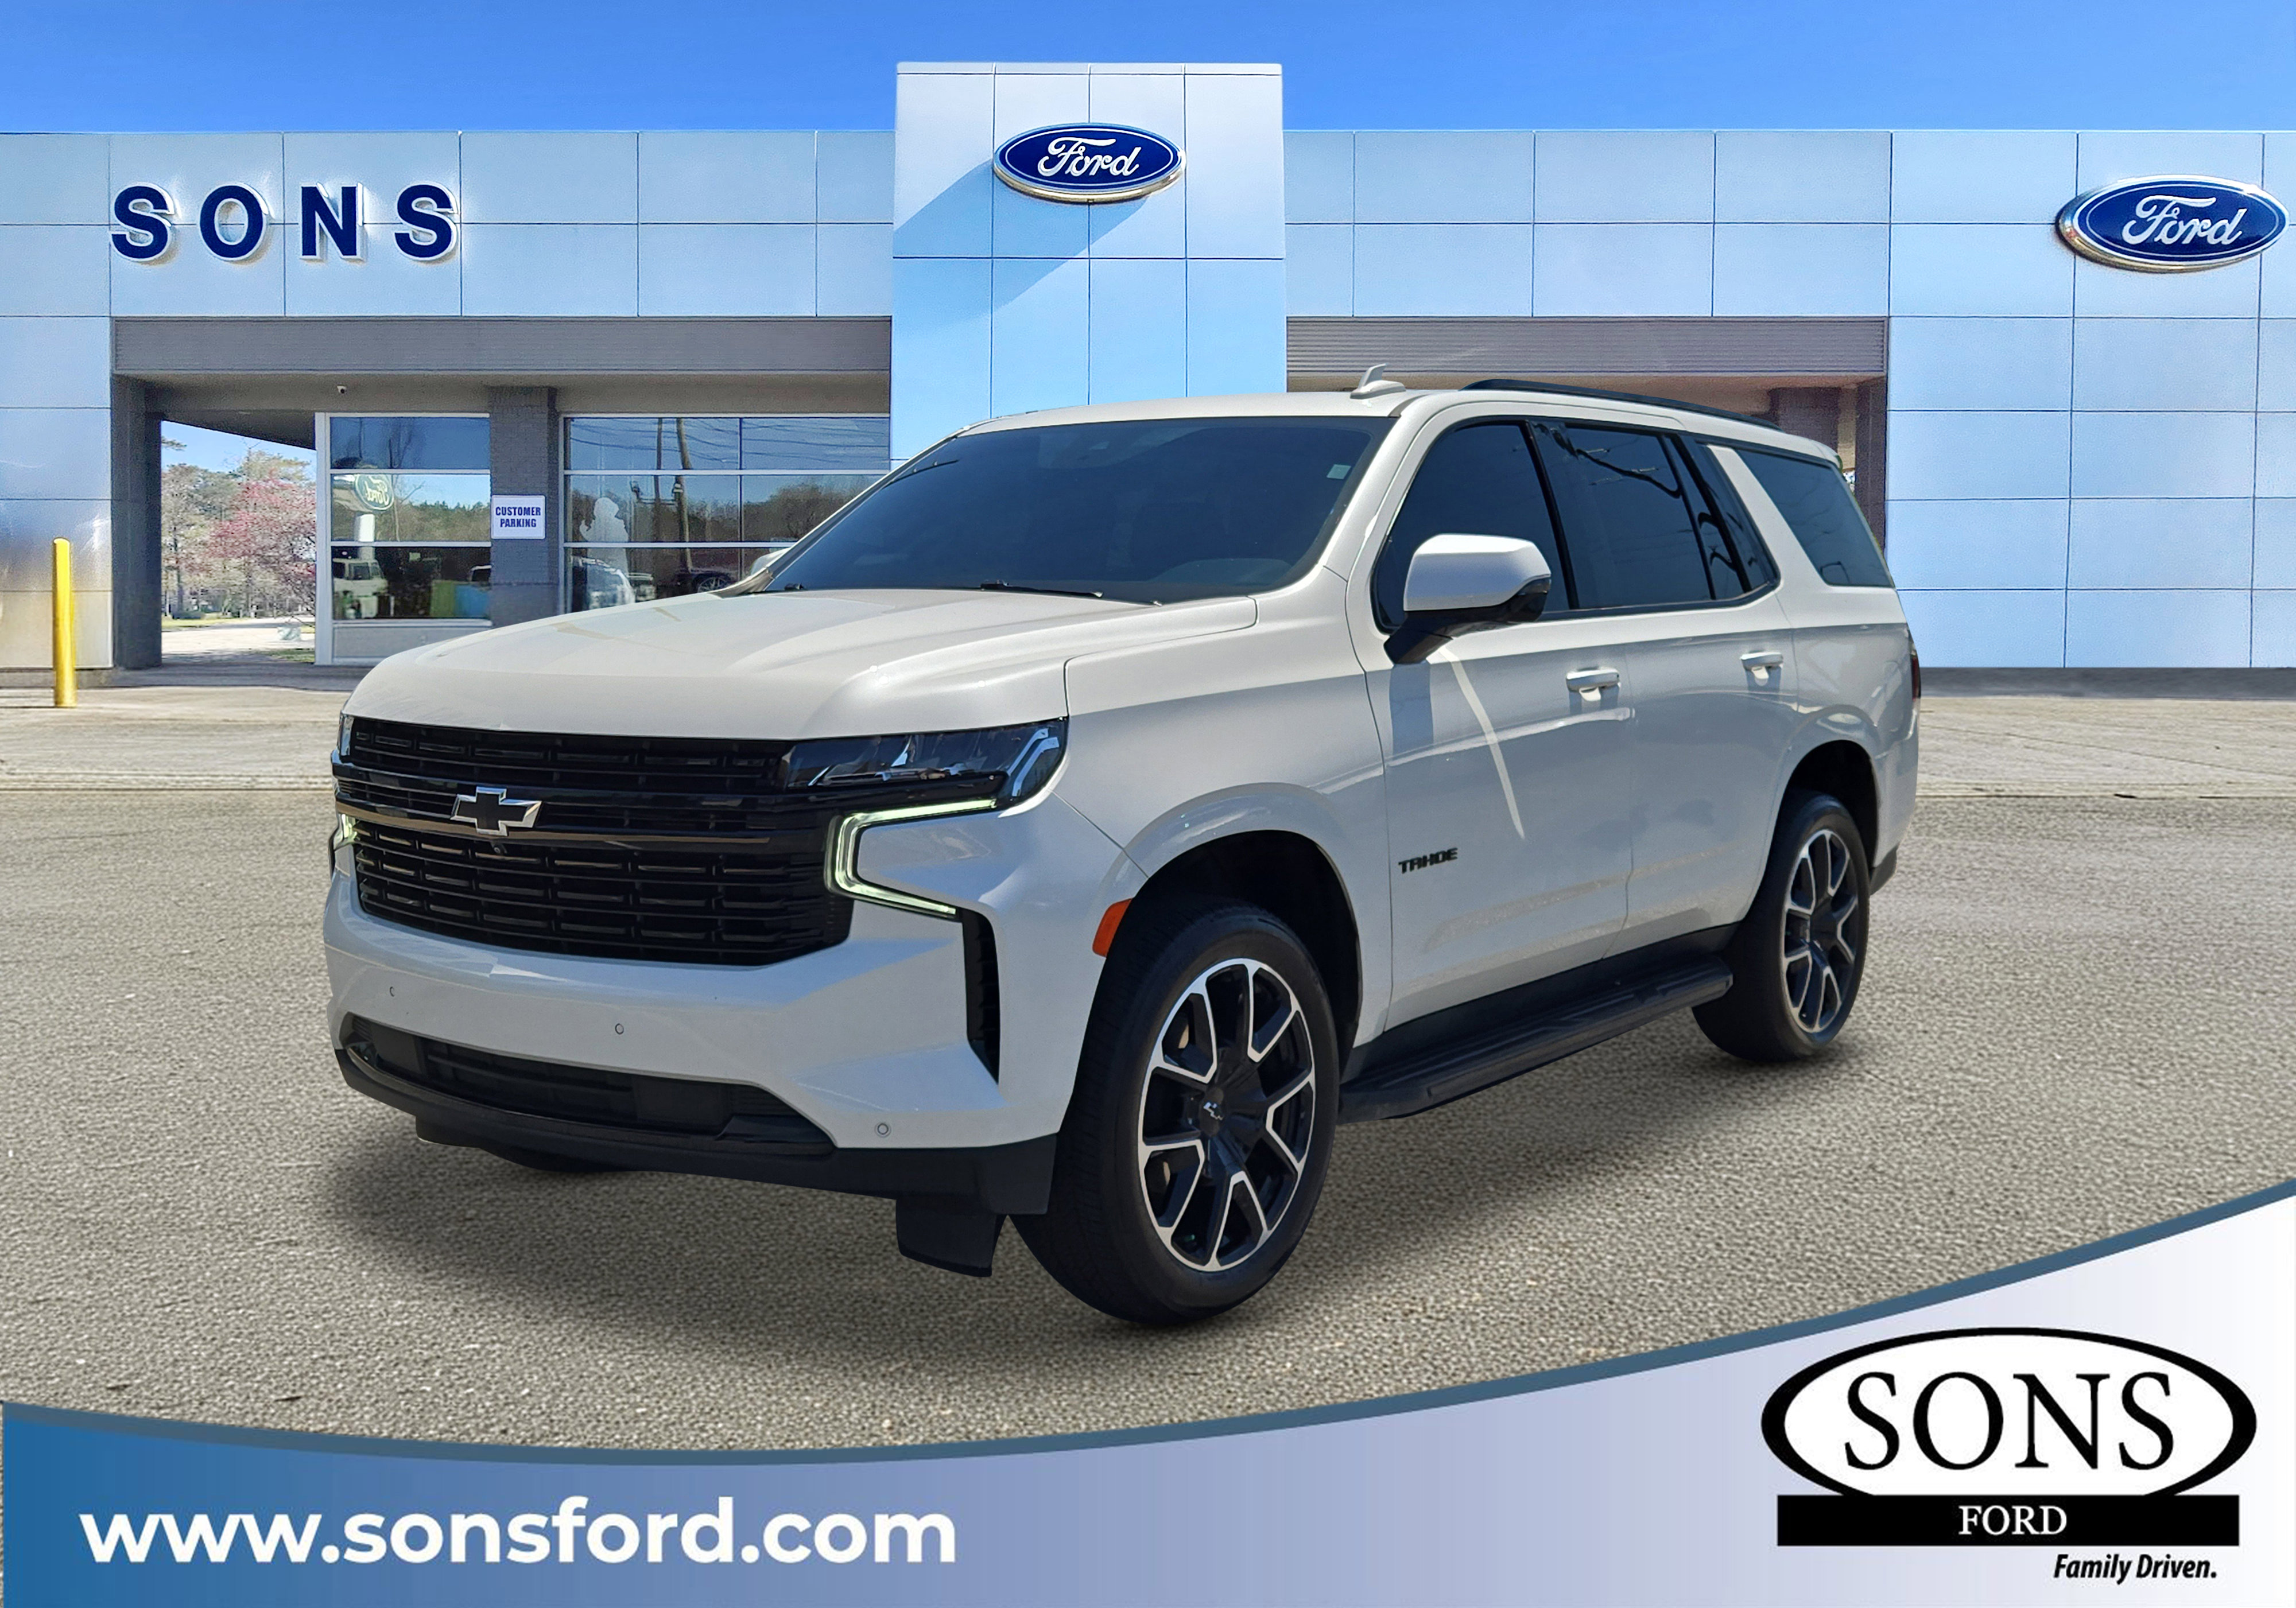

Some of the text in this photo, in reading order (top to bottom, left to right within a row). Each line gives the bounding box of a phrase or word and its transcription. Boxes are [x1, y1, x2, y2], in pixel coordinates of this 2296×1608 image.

[1037, 137, 1142, 176] Ford
[111, 184, 453, 259] SONS
[2122, 195, 2247, 245] Ford
[495, 506, 541, 516] CUSTOMER
[500, 518, 537, 527] PARKING
[1398, 847, 1458, 874] TAHOE
